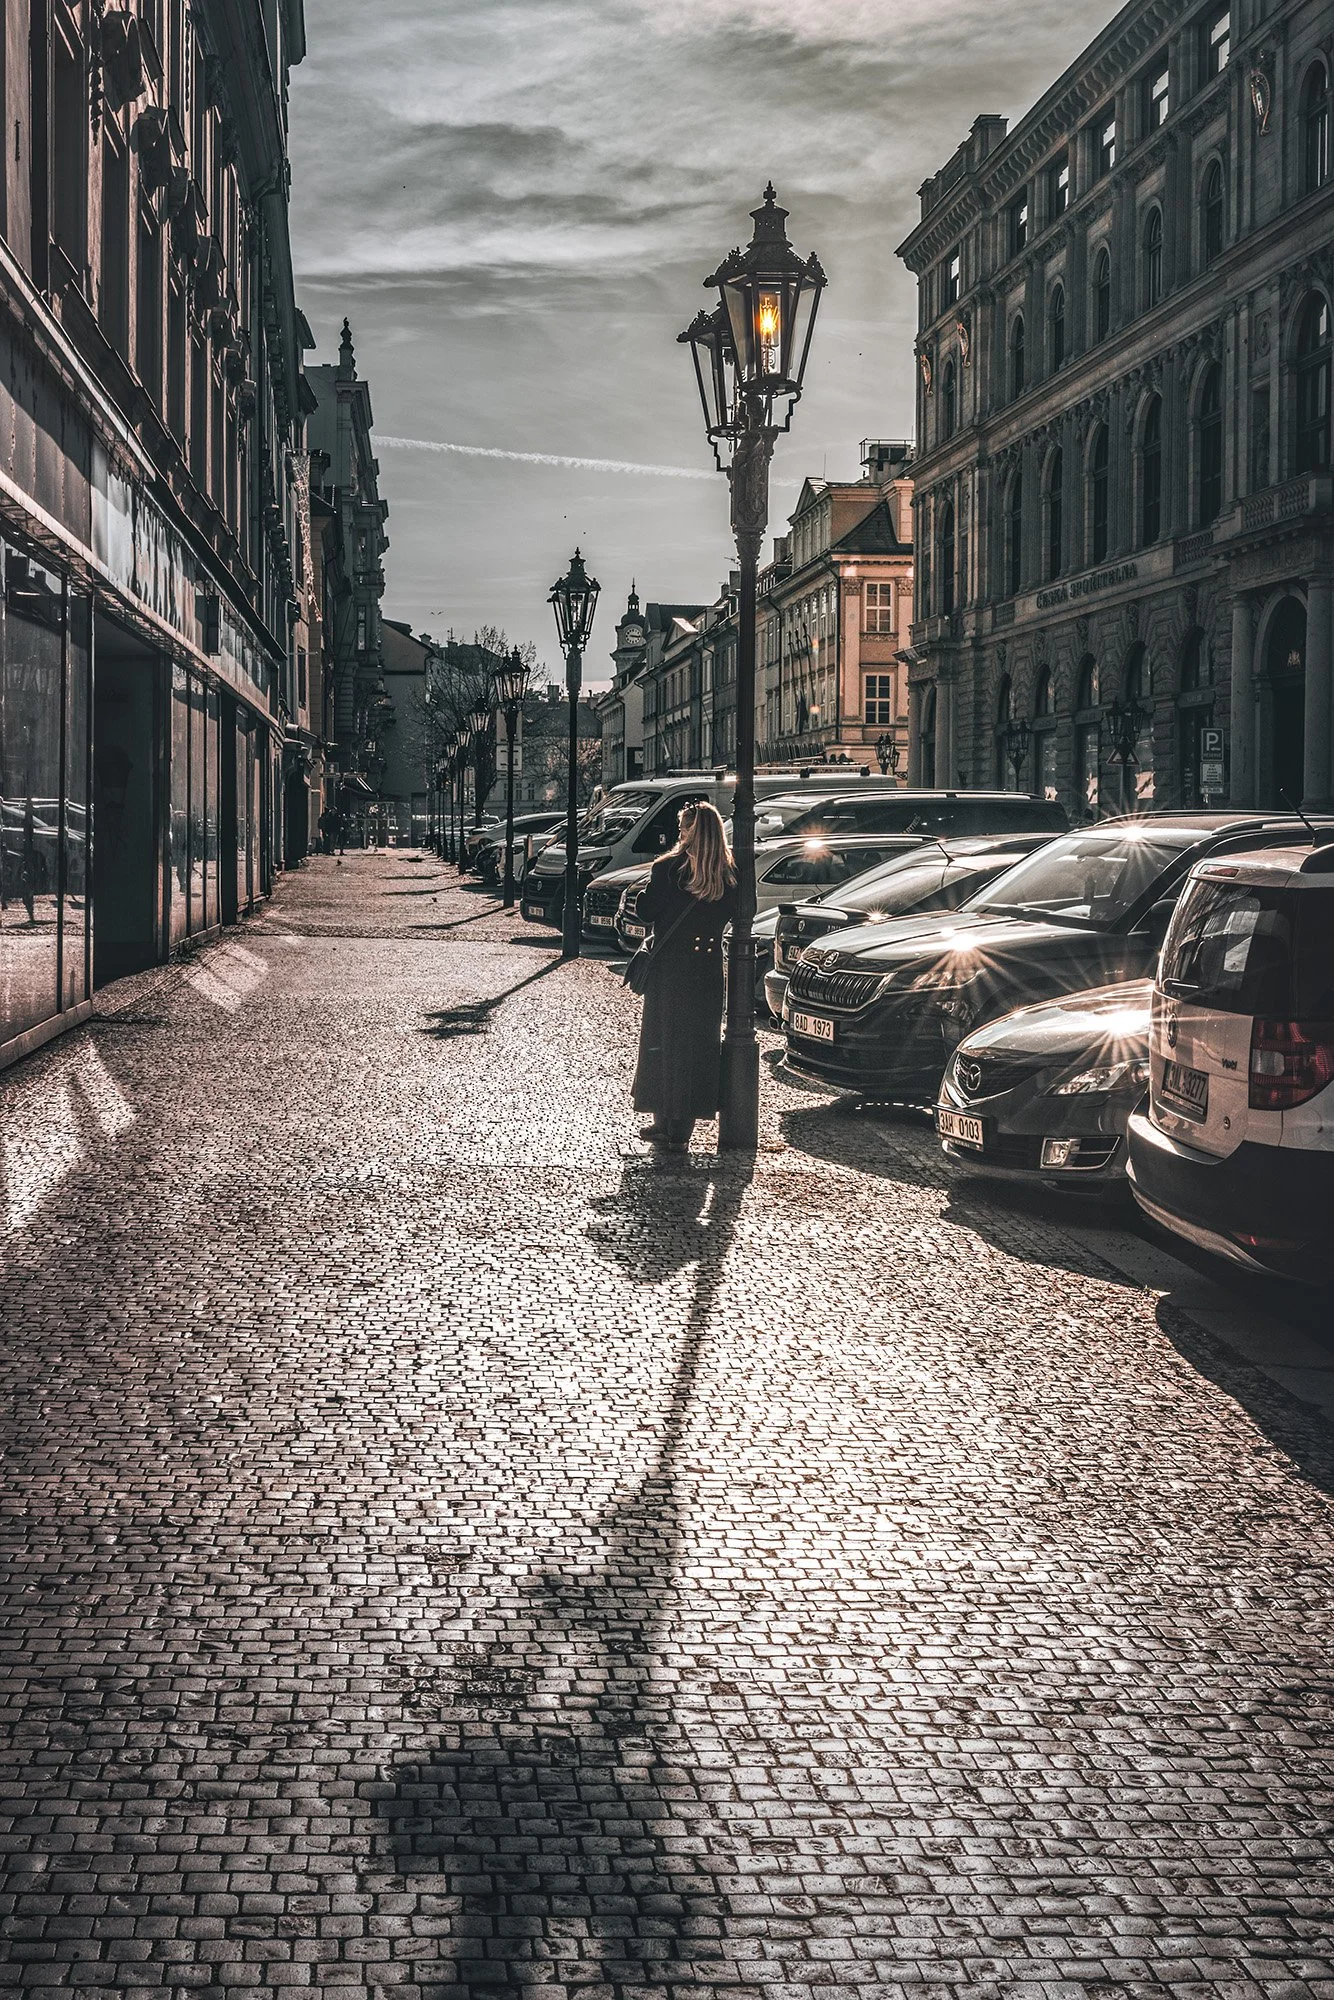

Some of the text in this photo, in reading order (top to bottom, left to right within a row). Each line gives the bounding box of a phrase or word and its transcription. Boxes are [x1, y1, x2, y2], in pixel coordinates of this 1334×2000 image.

[1206, 732, 1219, 751] P
[795, 1014, 831, 1038] 8AD 1973
[940, 1112, 980, 1141] 3AH 0103
